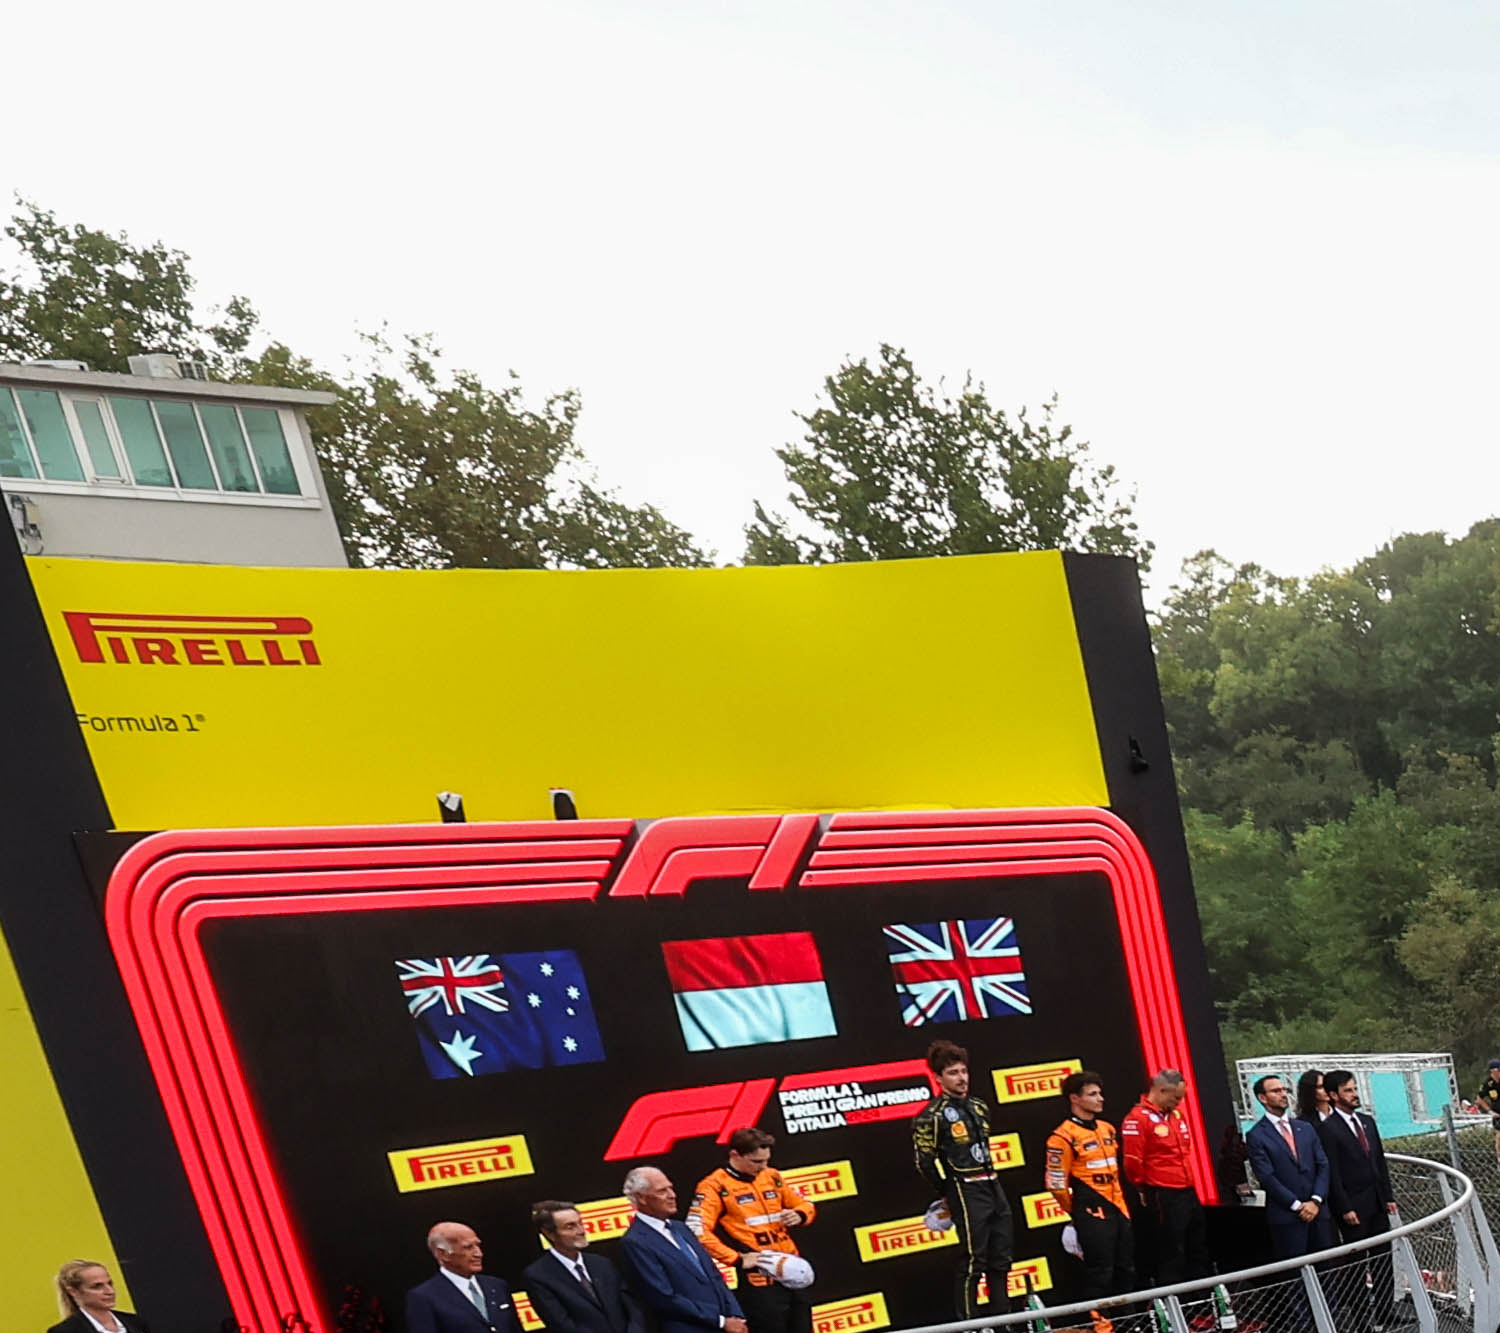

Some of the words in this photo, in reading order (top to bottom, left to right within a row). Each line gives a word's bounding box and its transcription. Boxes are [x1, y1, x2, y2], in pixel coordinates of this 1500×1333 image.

[61, 611, 321, 666] PIRELLI
[778, 1085, 854, 1106] FORMULA
[782, 1099, 838, 1121] PIRELLI
[836, 1093, 875, 1114] GRAN
[873, 1087, 931, 1107] PREMIO
[408, 1144, 516, 1183] PIRELLI
